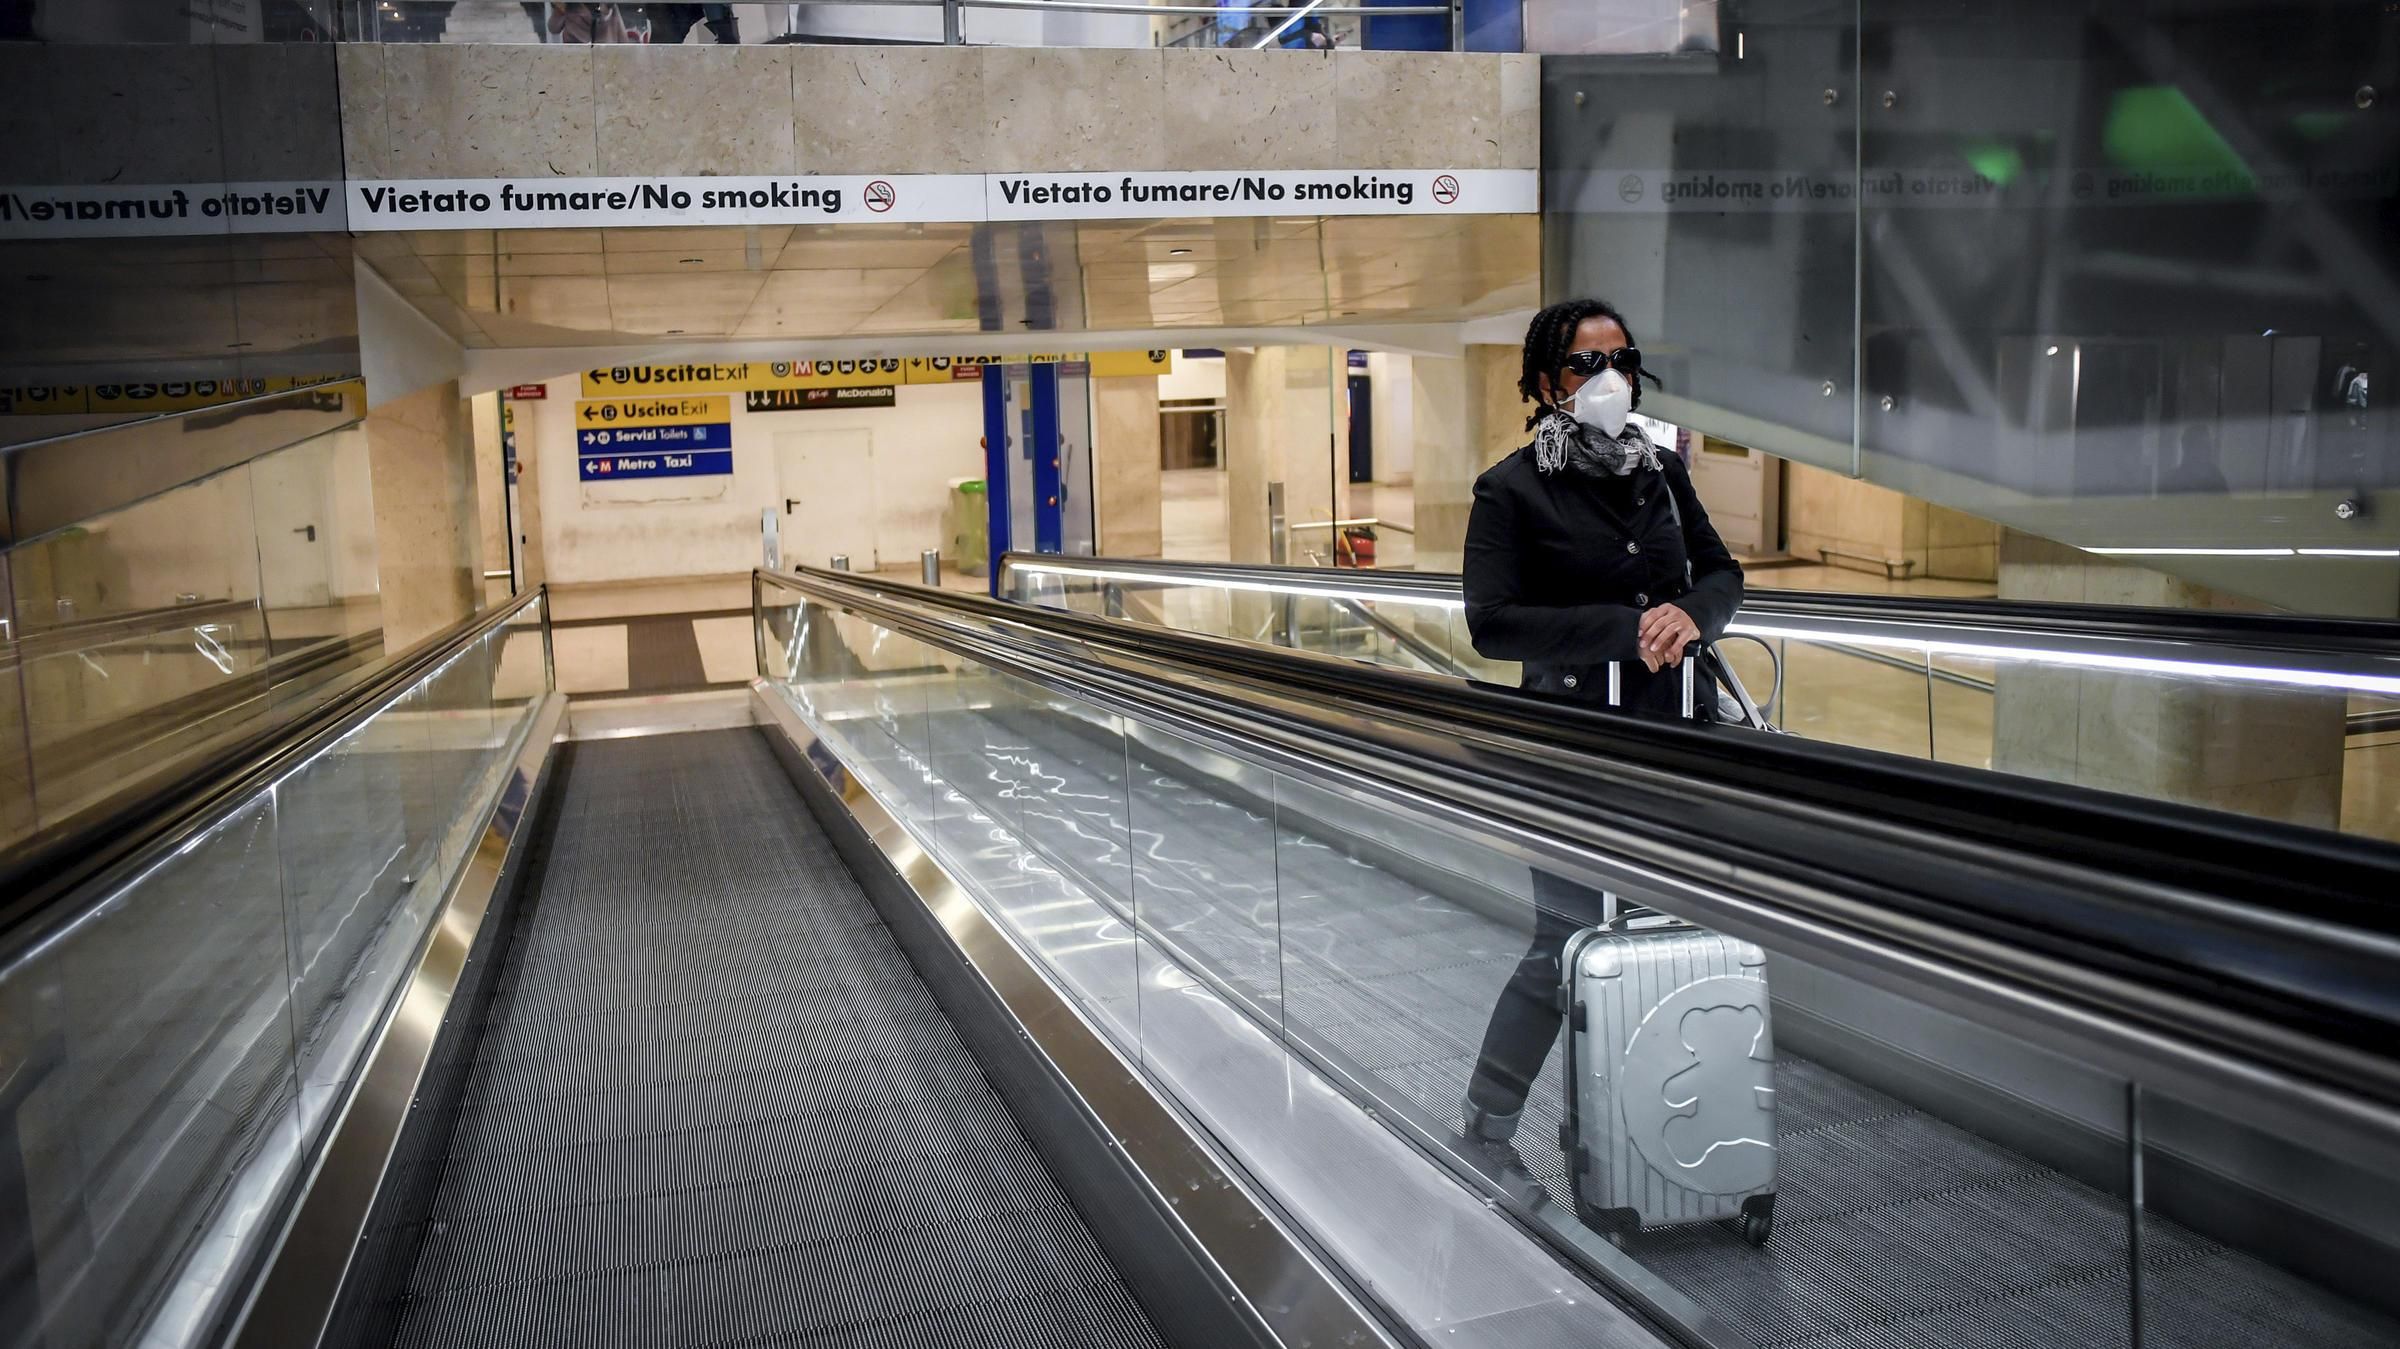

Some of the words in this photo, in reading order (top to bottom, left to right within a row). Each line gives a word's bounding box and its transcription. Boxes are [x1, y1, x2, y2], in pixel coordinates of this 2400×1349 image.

[360, 187, 491, 213] Vietato
[500, 184, 692, 211] fumare/No
[702, 182, 842, 213] smoking
[999, 180, 1112, 204] Vietato
[1120, 177, 1285, 202] fumare/No
[1294, 175, 1413, 204] smoking
[633, 364, 712, 384] Uscita
[713, 363, 749, 381] Exit
[837, 387, 893, 399] McDonald's
[623, 401, 679, 418] Uscita
[681, 400, 708, 416] Exit
[615, 428, 657, 442] Servizi
[659, 428, 688, 441] Toilets
[618, 458, 657, 471] Metro
[664, 453, 693, 469] Taxi
